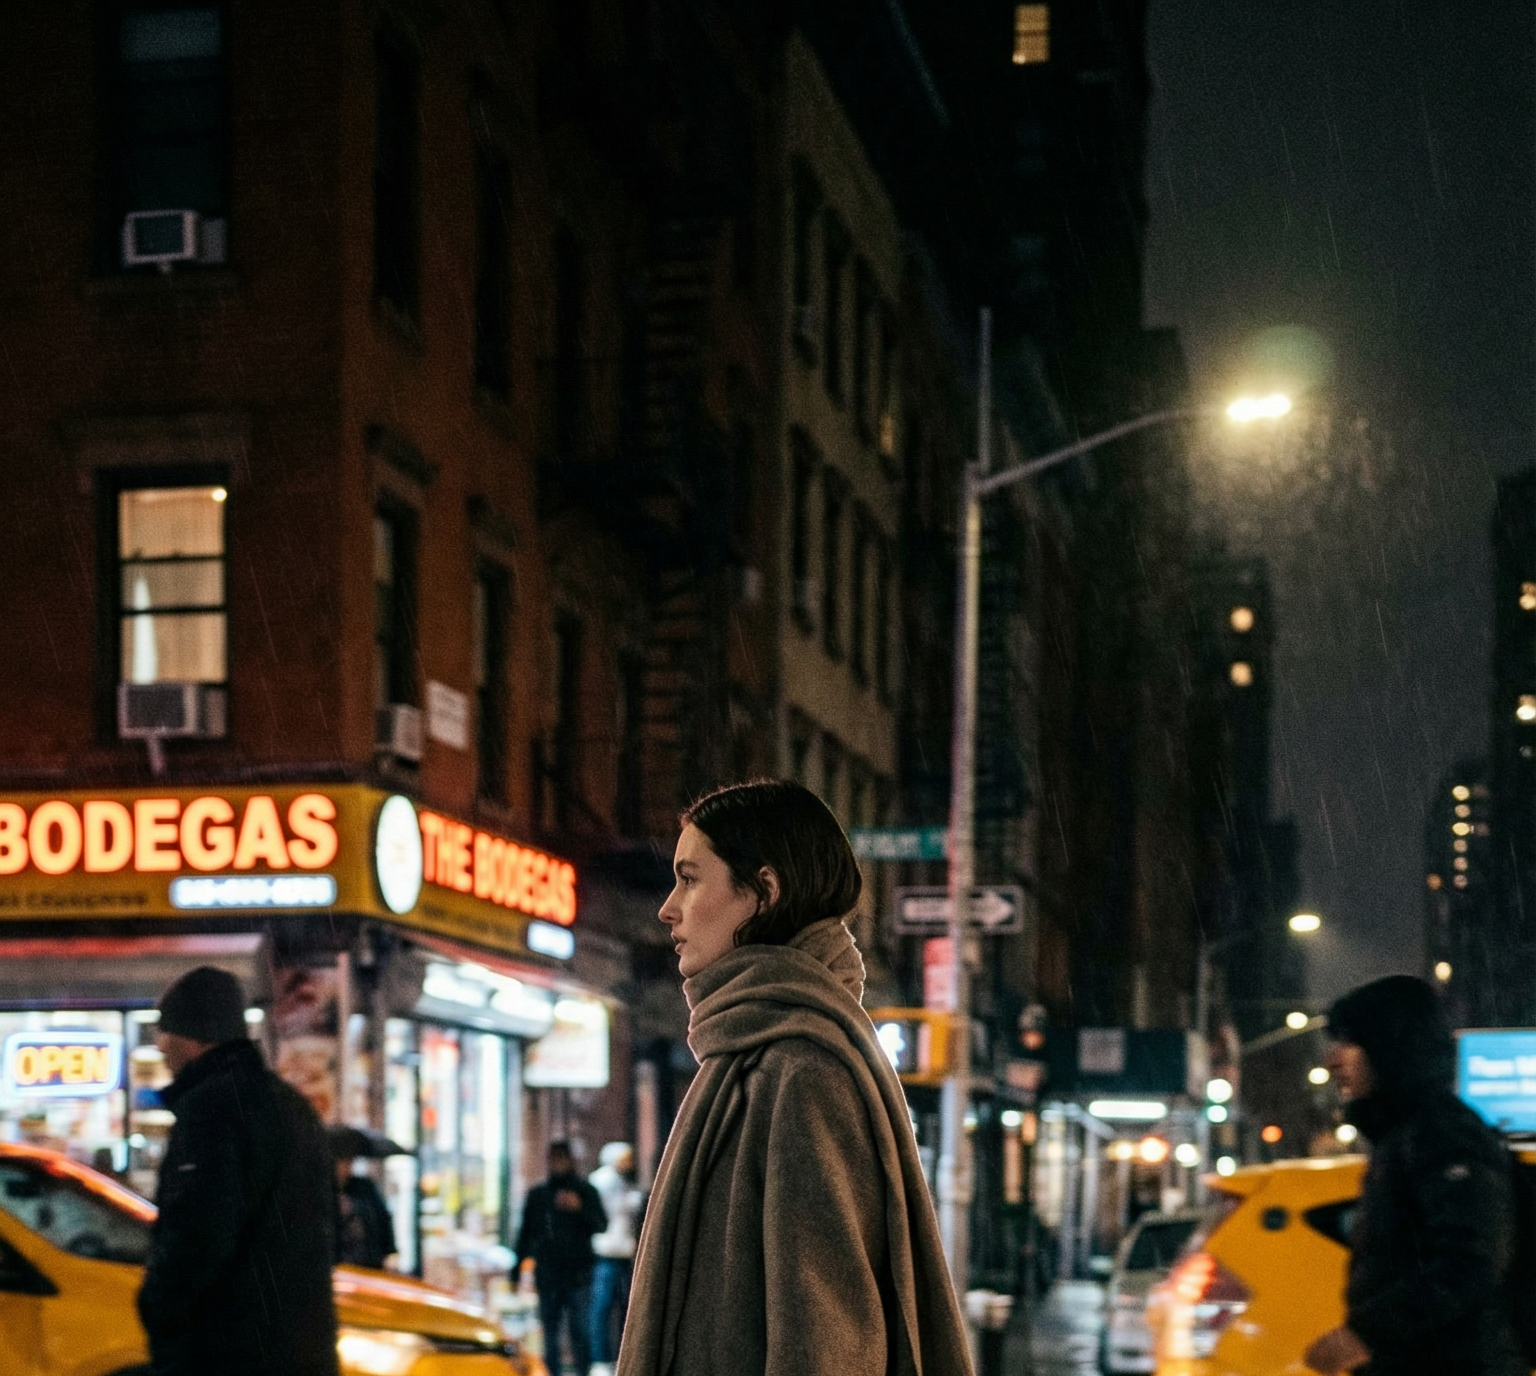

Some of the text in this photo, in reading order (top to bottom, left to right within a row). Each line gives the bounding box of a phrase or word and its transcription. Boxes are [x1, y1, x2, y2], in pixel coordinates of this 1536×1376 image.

[0, 794, 338, 875] BODEGAS
[419, 811, 473, 893] THE
[474, 831, 577, 926] BODEGAS
[14, 1046, 110, 1085] OPEN
